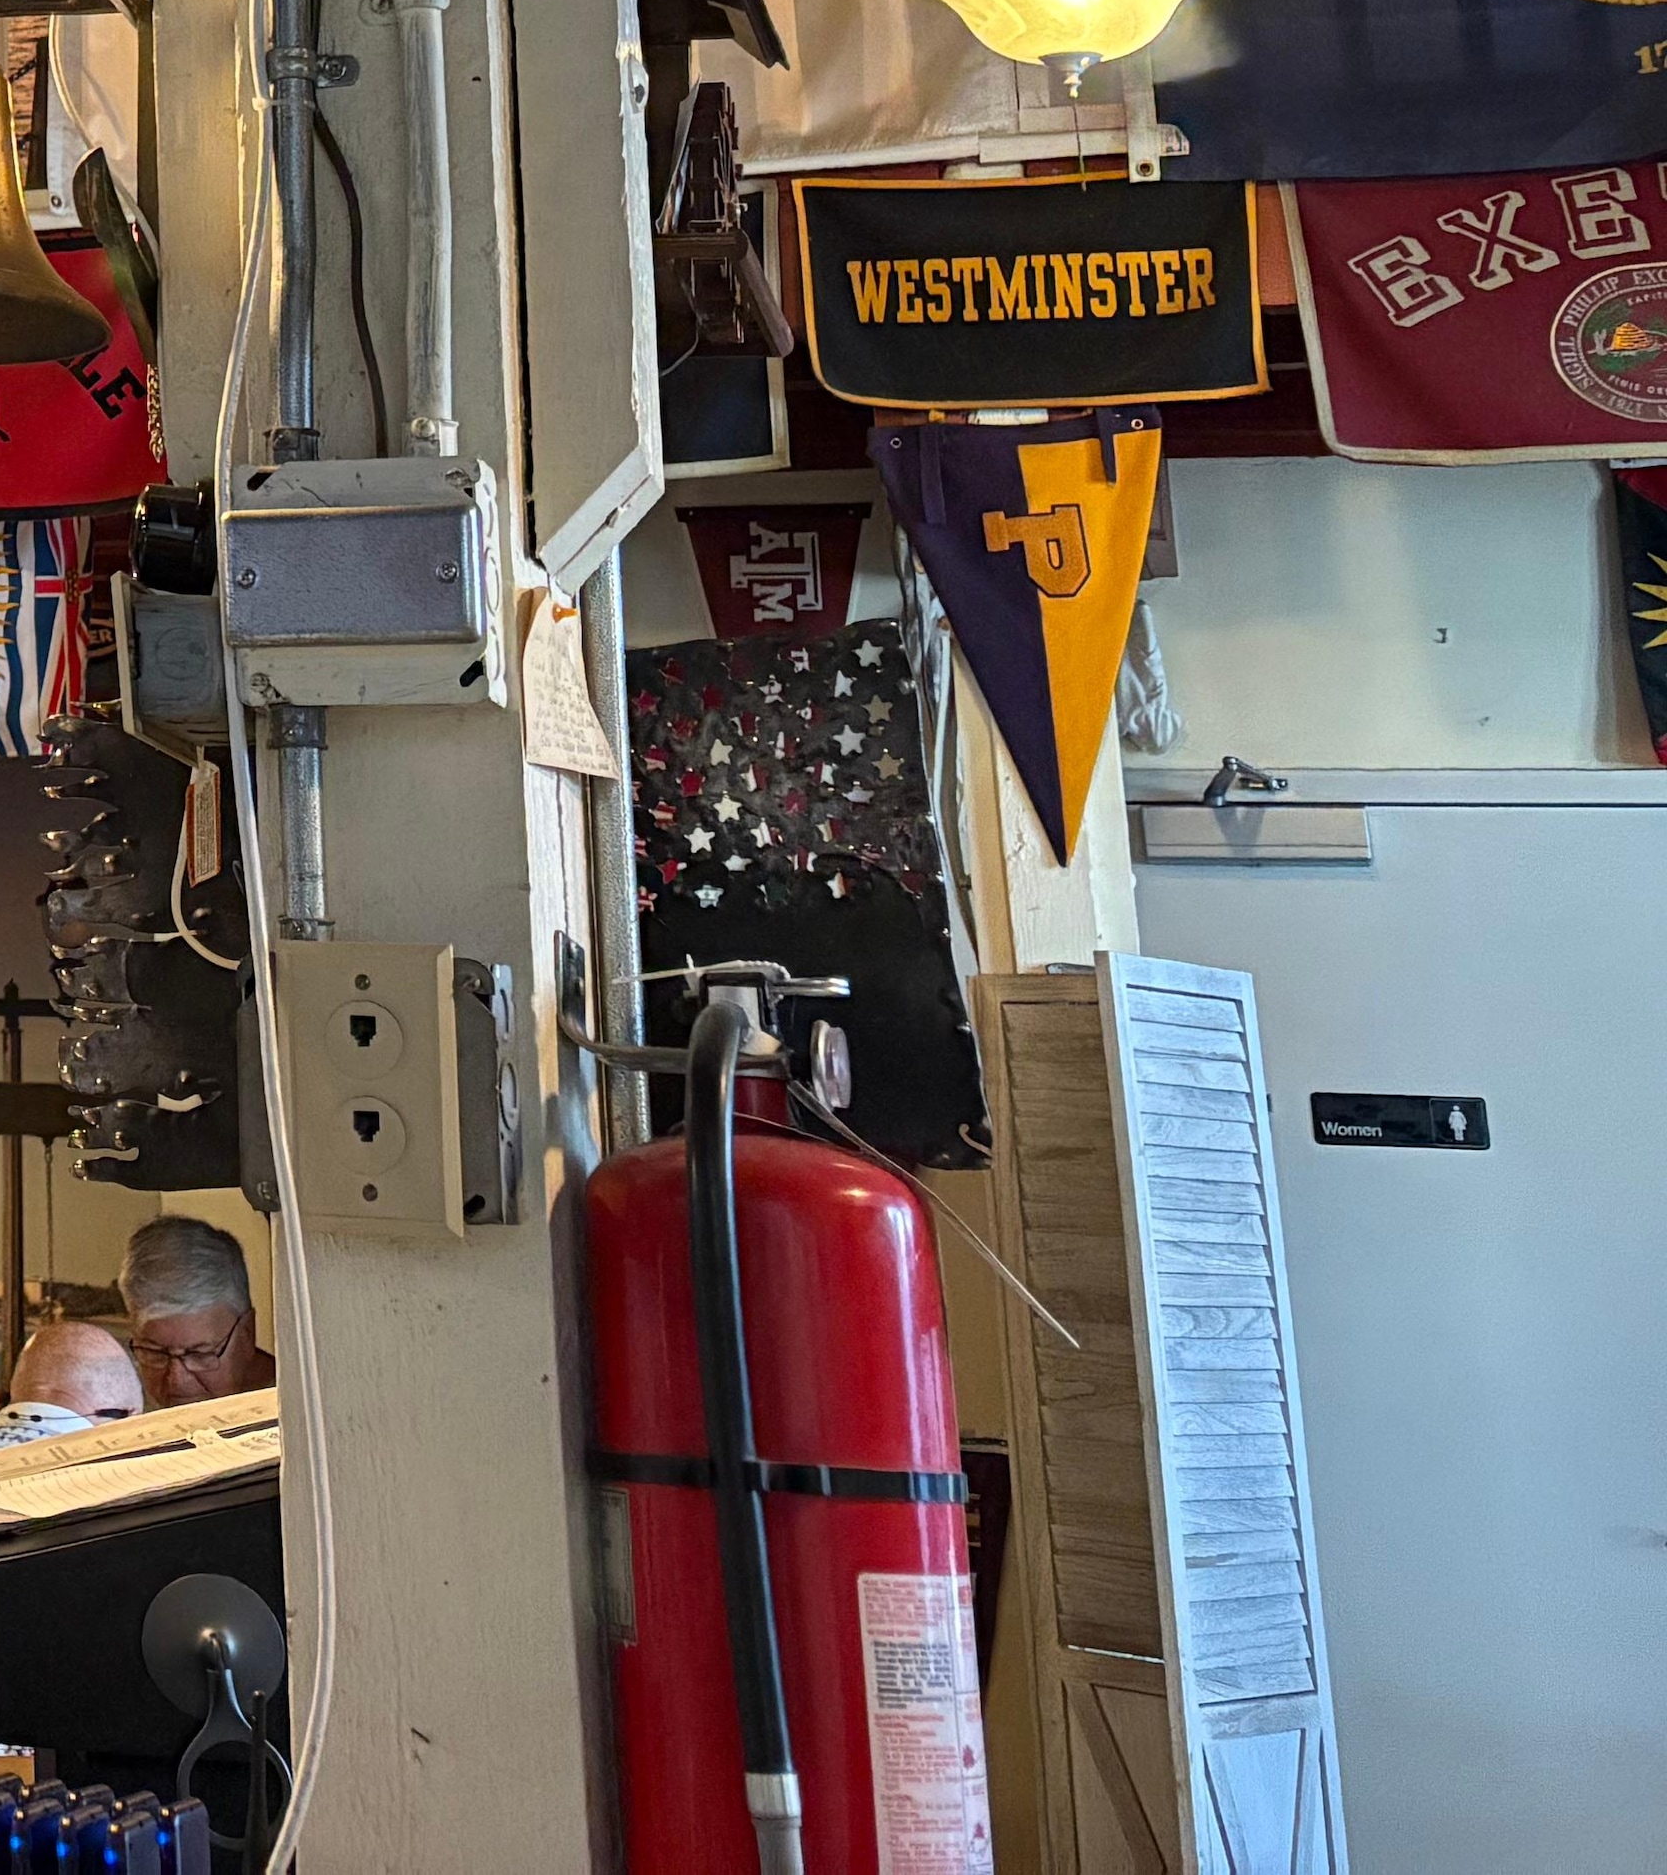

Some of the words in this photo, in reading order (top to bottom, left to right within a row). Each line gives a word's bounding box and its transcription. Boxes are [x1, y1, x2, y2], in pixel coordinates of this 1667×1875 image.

[846, 248, 1216, 324] WESTMINSTER
[1347, 163, 1667, 327] EXE
[982, 503, 1091, 598] P
[1320, 1121, 1382, 1139] Women
